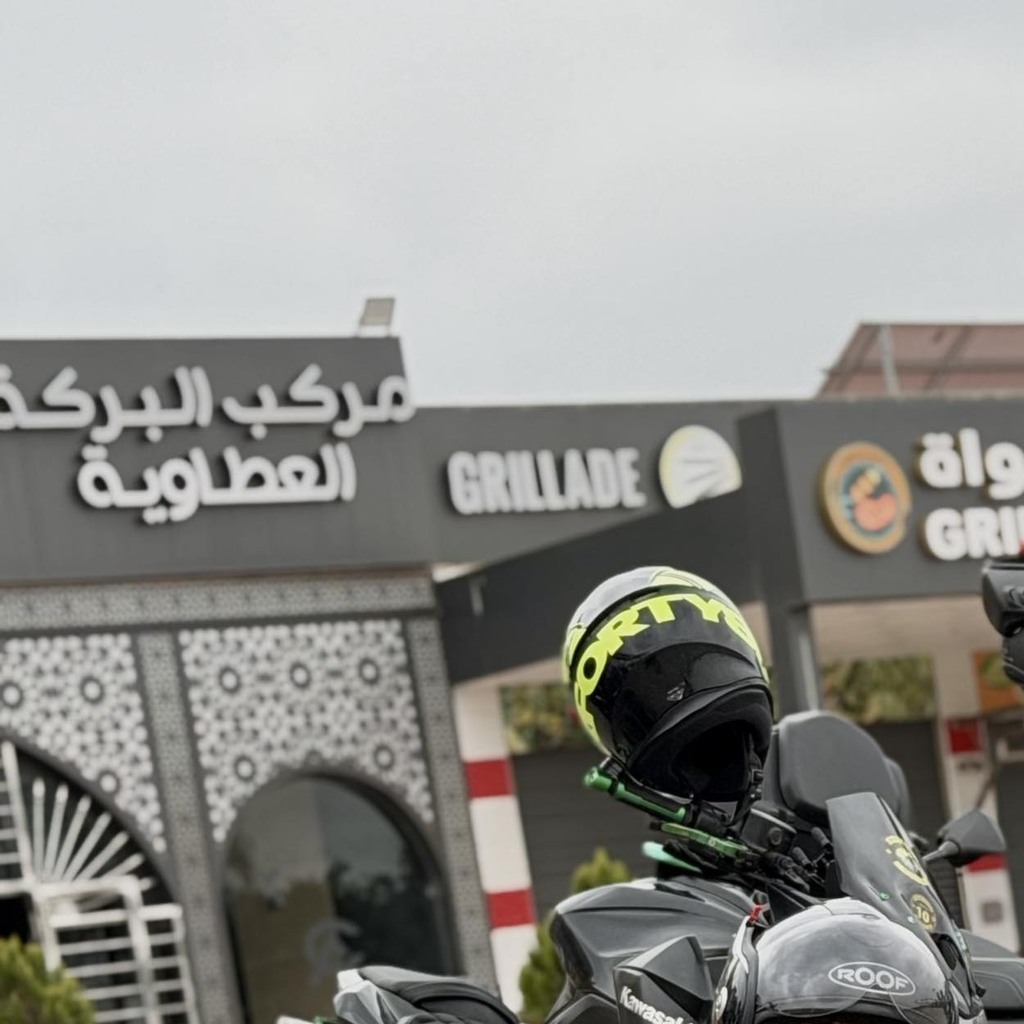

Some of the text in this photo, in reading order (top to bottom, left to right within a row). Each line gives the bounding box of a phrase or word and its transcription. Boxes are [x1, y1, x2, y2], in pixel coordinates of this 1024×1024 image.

[221, 363, 416, 439] مركب
[78, 442, 357, 525] العطاوية
[447, 447, 647, 515] GRILLADE
[837, 967, 909, 990] ROOF
